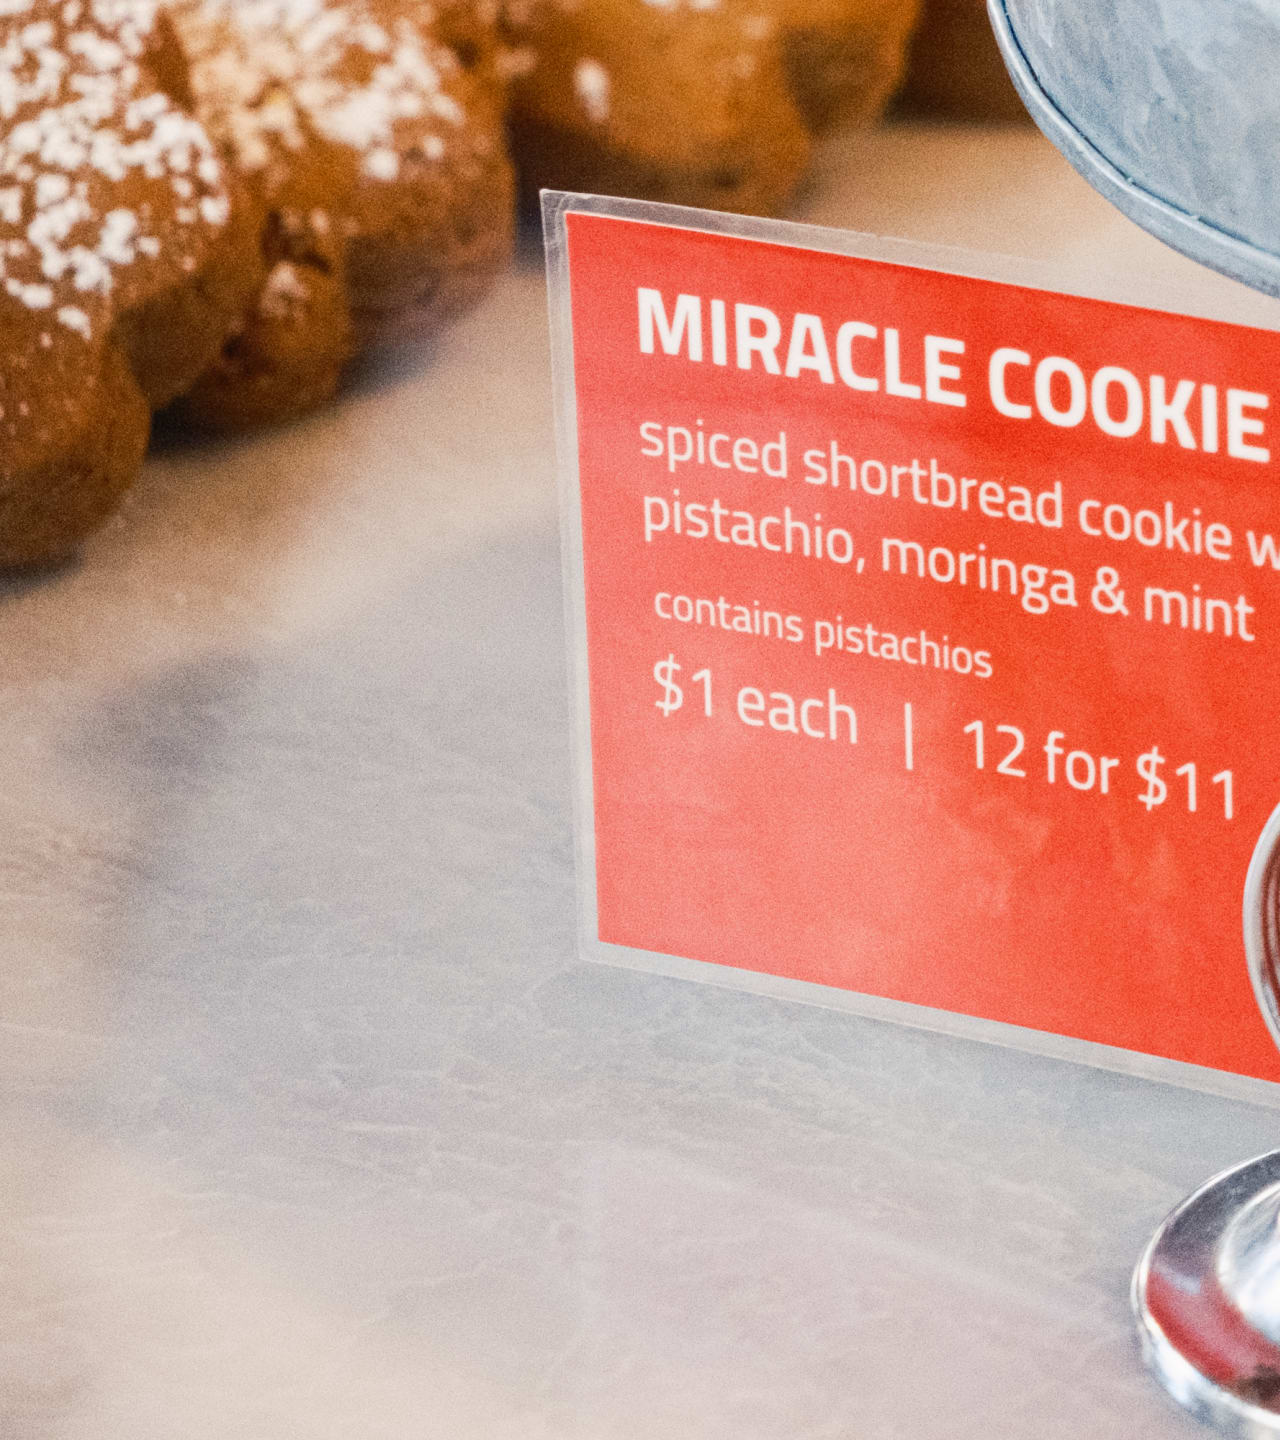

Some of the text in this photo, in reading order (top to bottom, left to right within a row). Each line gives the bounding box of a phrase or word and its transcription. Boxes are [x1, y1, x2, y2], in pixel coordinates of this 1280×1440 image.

[637, 286, 1272, 464] MIRACLE COOKIE
[640, 419, 788, 479] spiced
[803, 441, 1064, 529] shortbread
[1077, 497, 1233, 562] cookie
[643, 493, 1255, 643] pistachio, moringa & mint
[654, 592, 993, 679] contains pistachios
[653, 655, 713, 717] $1
[736, 685, 858, 744] each
[963, 719, 1026, 779] 12
[1043, 728, 1120, 795] for
[1135, 746, 1235, 821] $11
